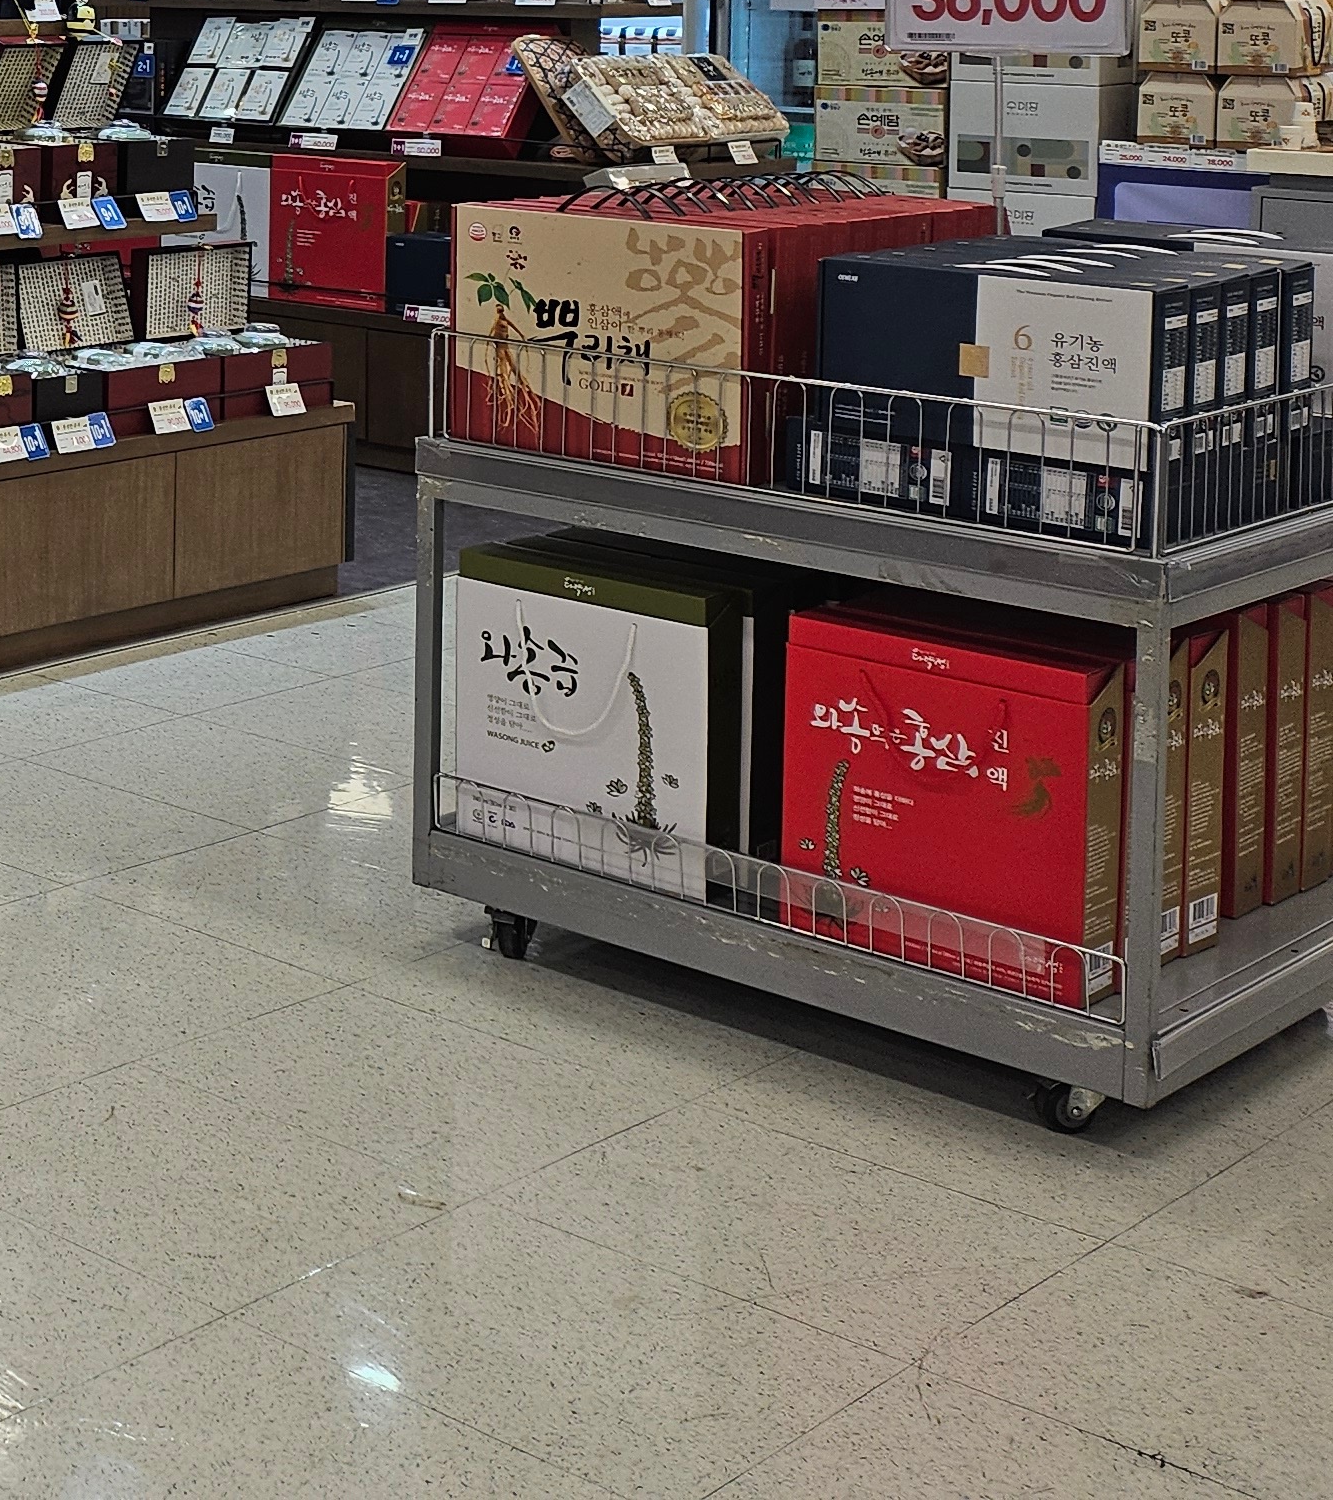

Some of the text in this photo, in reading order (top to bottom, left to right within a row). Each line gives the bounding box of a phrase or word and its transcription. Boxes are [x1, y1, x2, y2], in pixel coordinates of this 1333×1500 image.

[856, 112, 900, 129] 손예담
[586, 317, 622, 332] 인삼이
[1013, 324, 1033, 352] 6
[1050, 331, 1105, 353] 유기농
[1048, 351, 1118, 376] 홍삼진액
[578, 377, 619, 396] GOLD
[480, 625, 579, 698] 와송즙
[486, 729, 540, 750] WASONG JUICE
